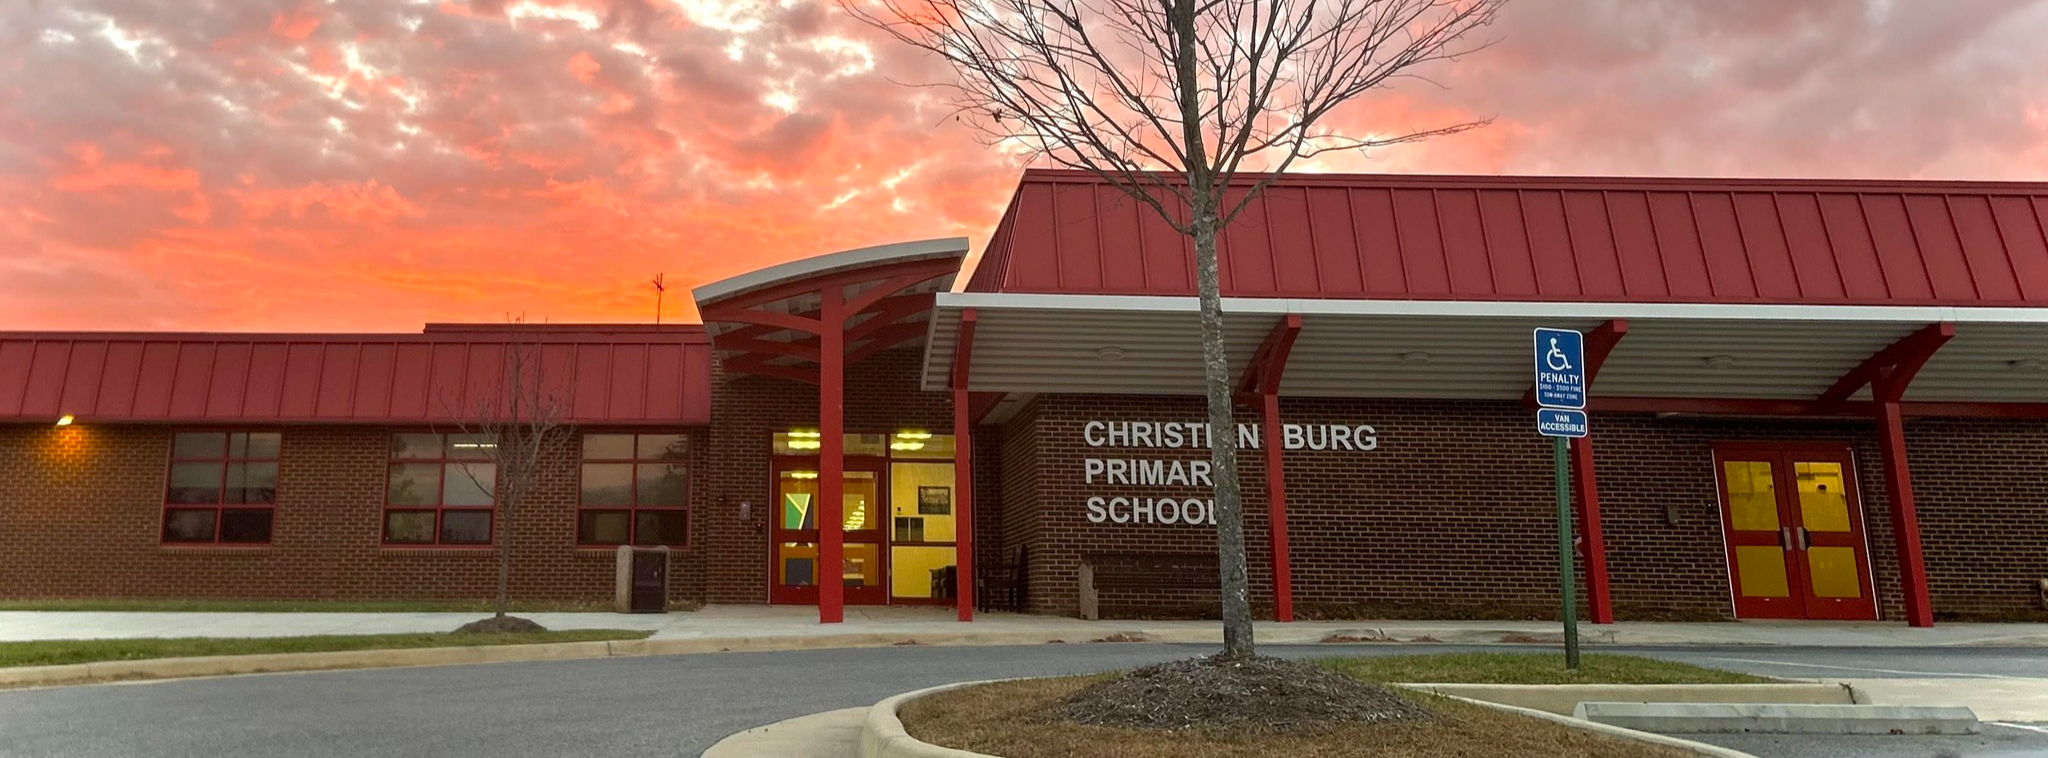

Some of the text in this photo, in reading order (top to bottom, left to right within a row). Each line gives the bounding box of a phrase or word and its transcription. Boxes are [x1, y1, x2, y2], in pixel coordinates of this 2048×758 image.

[1540, 372, 1579, 384] PENALTY
[1554, 414, 1570, 422] VAN
[1540, 422, 1585, 432] ACCESSIBLE
[1084, 421, 1378, 450] CHRISTINBURG
[1085, 458, 1214, 486] PRIMAR
